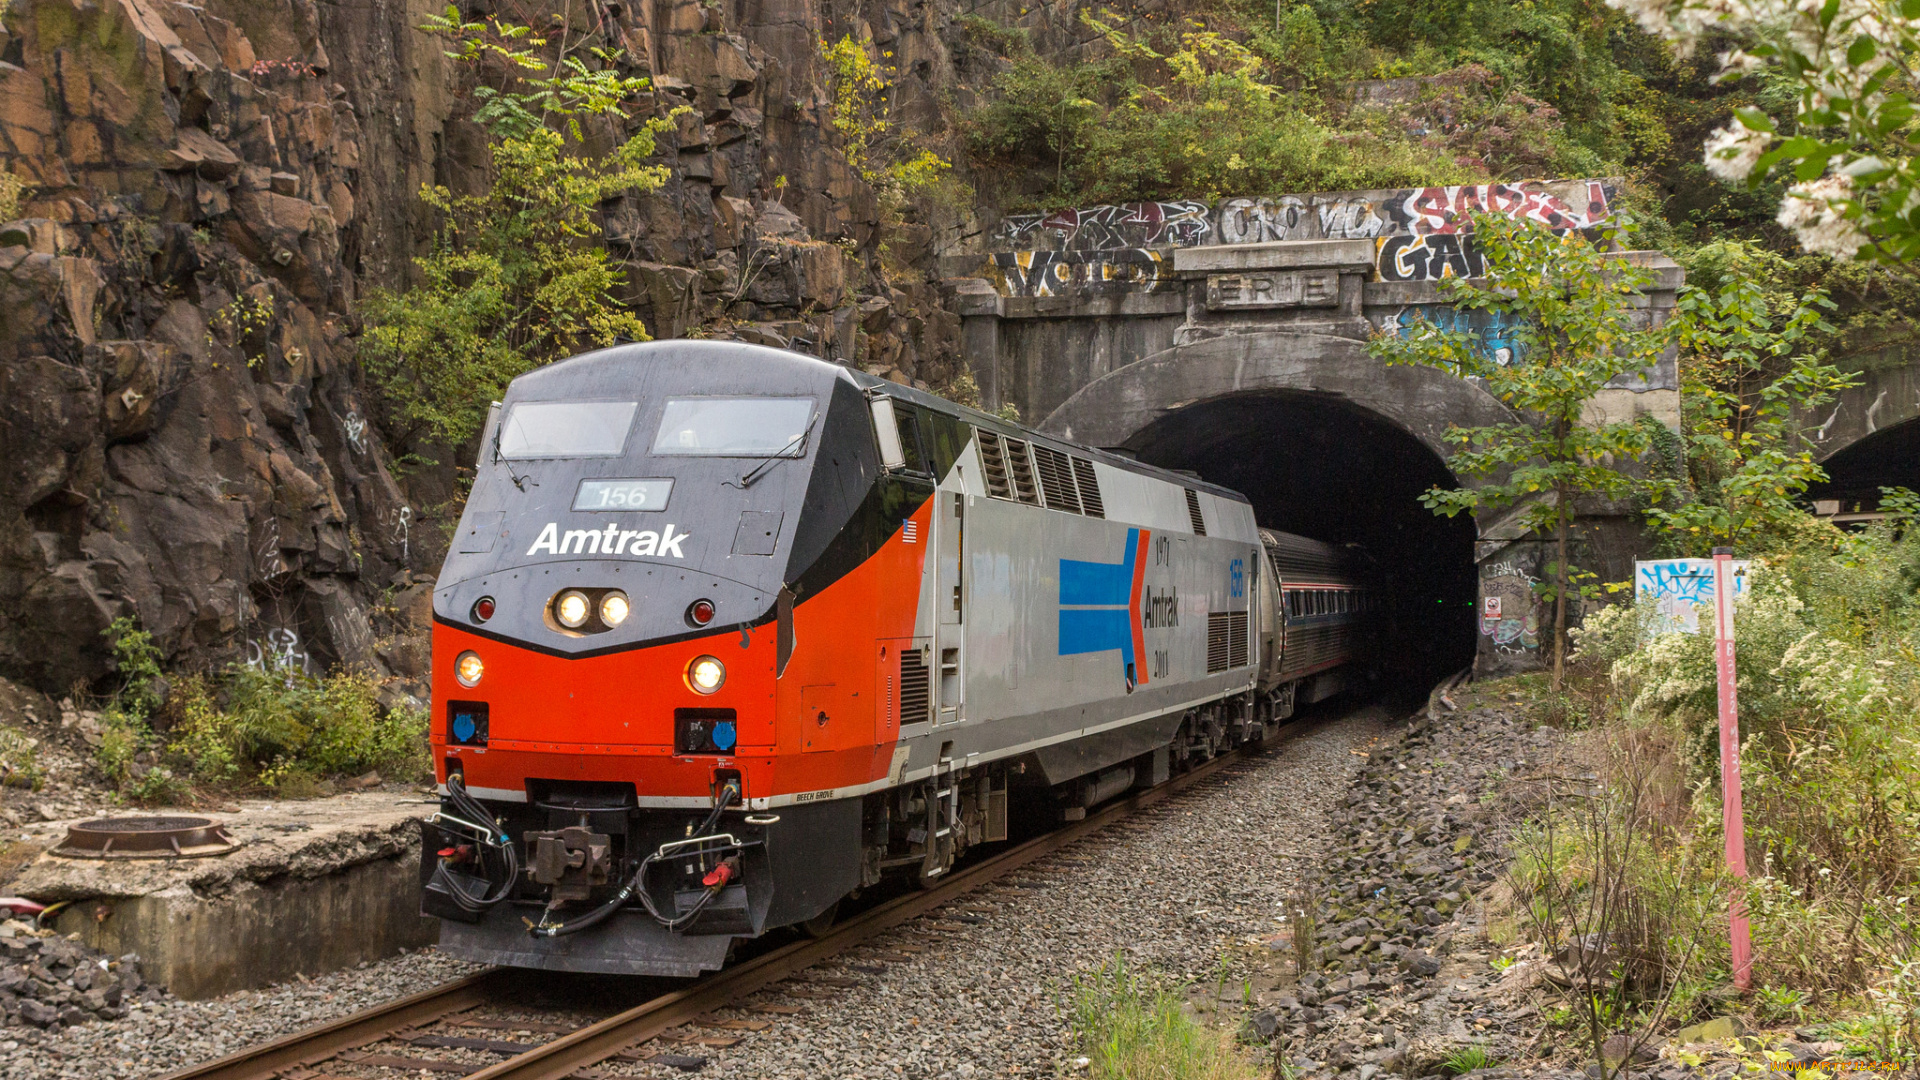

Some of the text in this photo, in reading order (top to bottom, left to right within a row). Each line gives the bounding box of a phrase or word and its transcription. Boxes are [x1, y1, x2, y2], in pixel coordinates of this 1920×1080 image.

[1218, 276, 1327, 301] ERIE
[599, 487, 647, 508] 156
[526, 522, 690, 558] Amtrak
[1156, 536, 1170, 567] 1971
[1230, 559, 1243, 598] 156
[1144, 585, 1179, 628] Amtrak
[1154, 650, 1169, 679] 2011
[796, 790, 833, 802] BEECH GROVE
